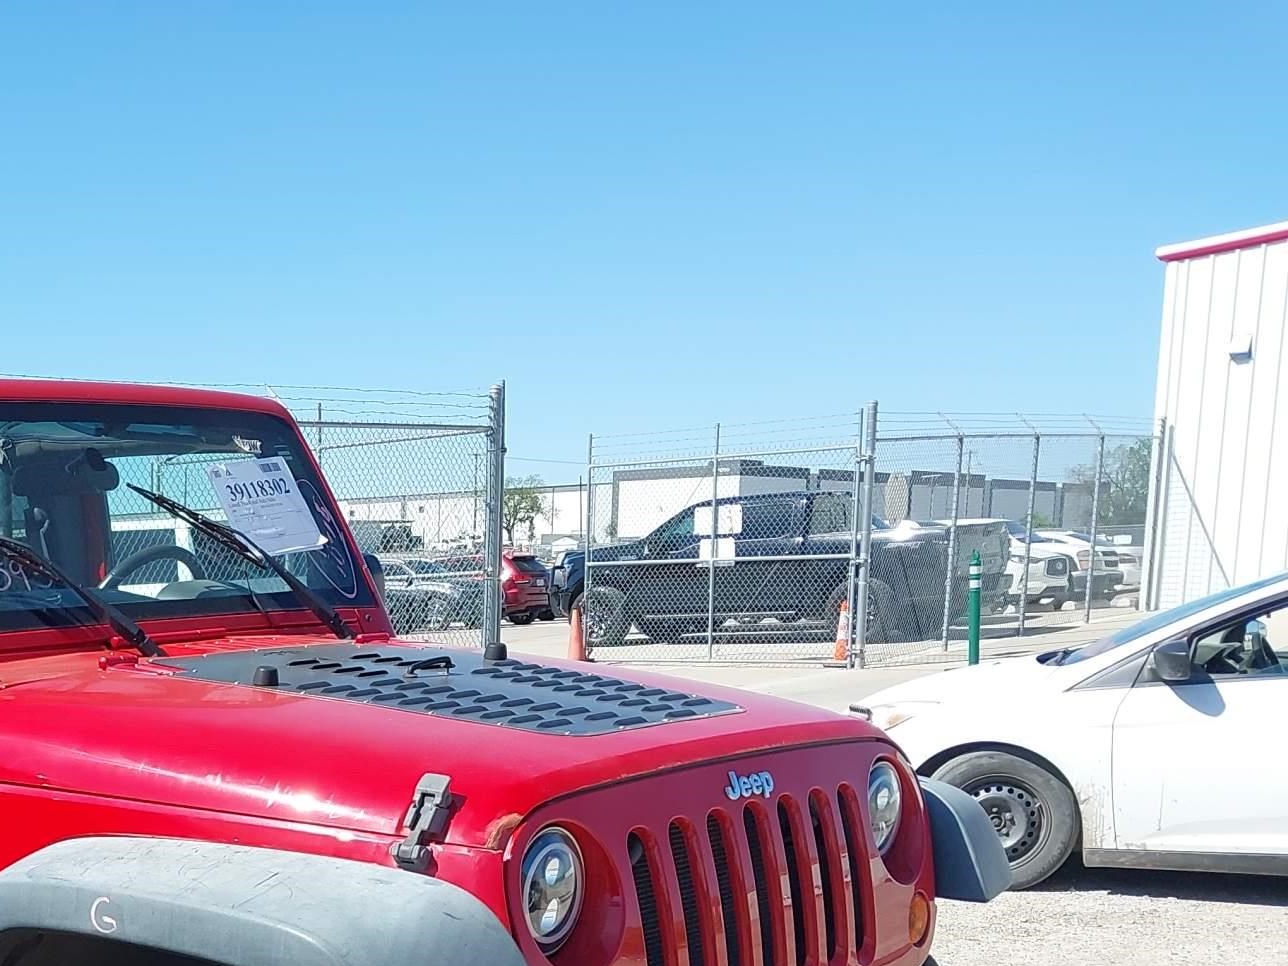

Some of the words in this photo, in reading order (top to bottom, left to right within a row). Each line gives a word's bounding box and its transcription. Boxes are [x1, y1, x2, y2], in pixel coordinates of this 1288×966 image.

[226, 478, 291, 502] 39118302
[725, 770, 774, 800] Jeep
[90, 896, 117, 934] G
